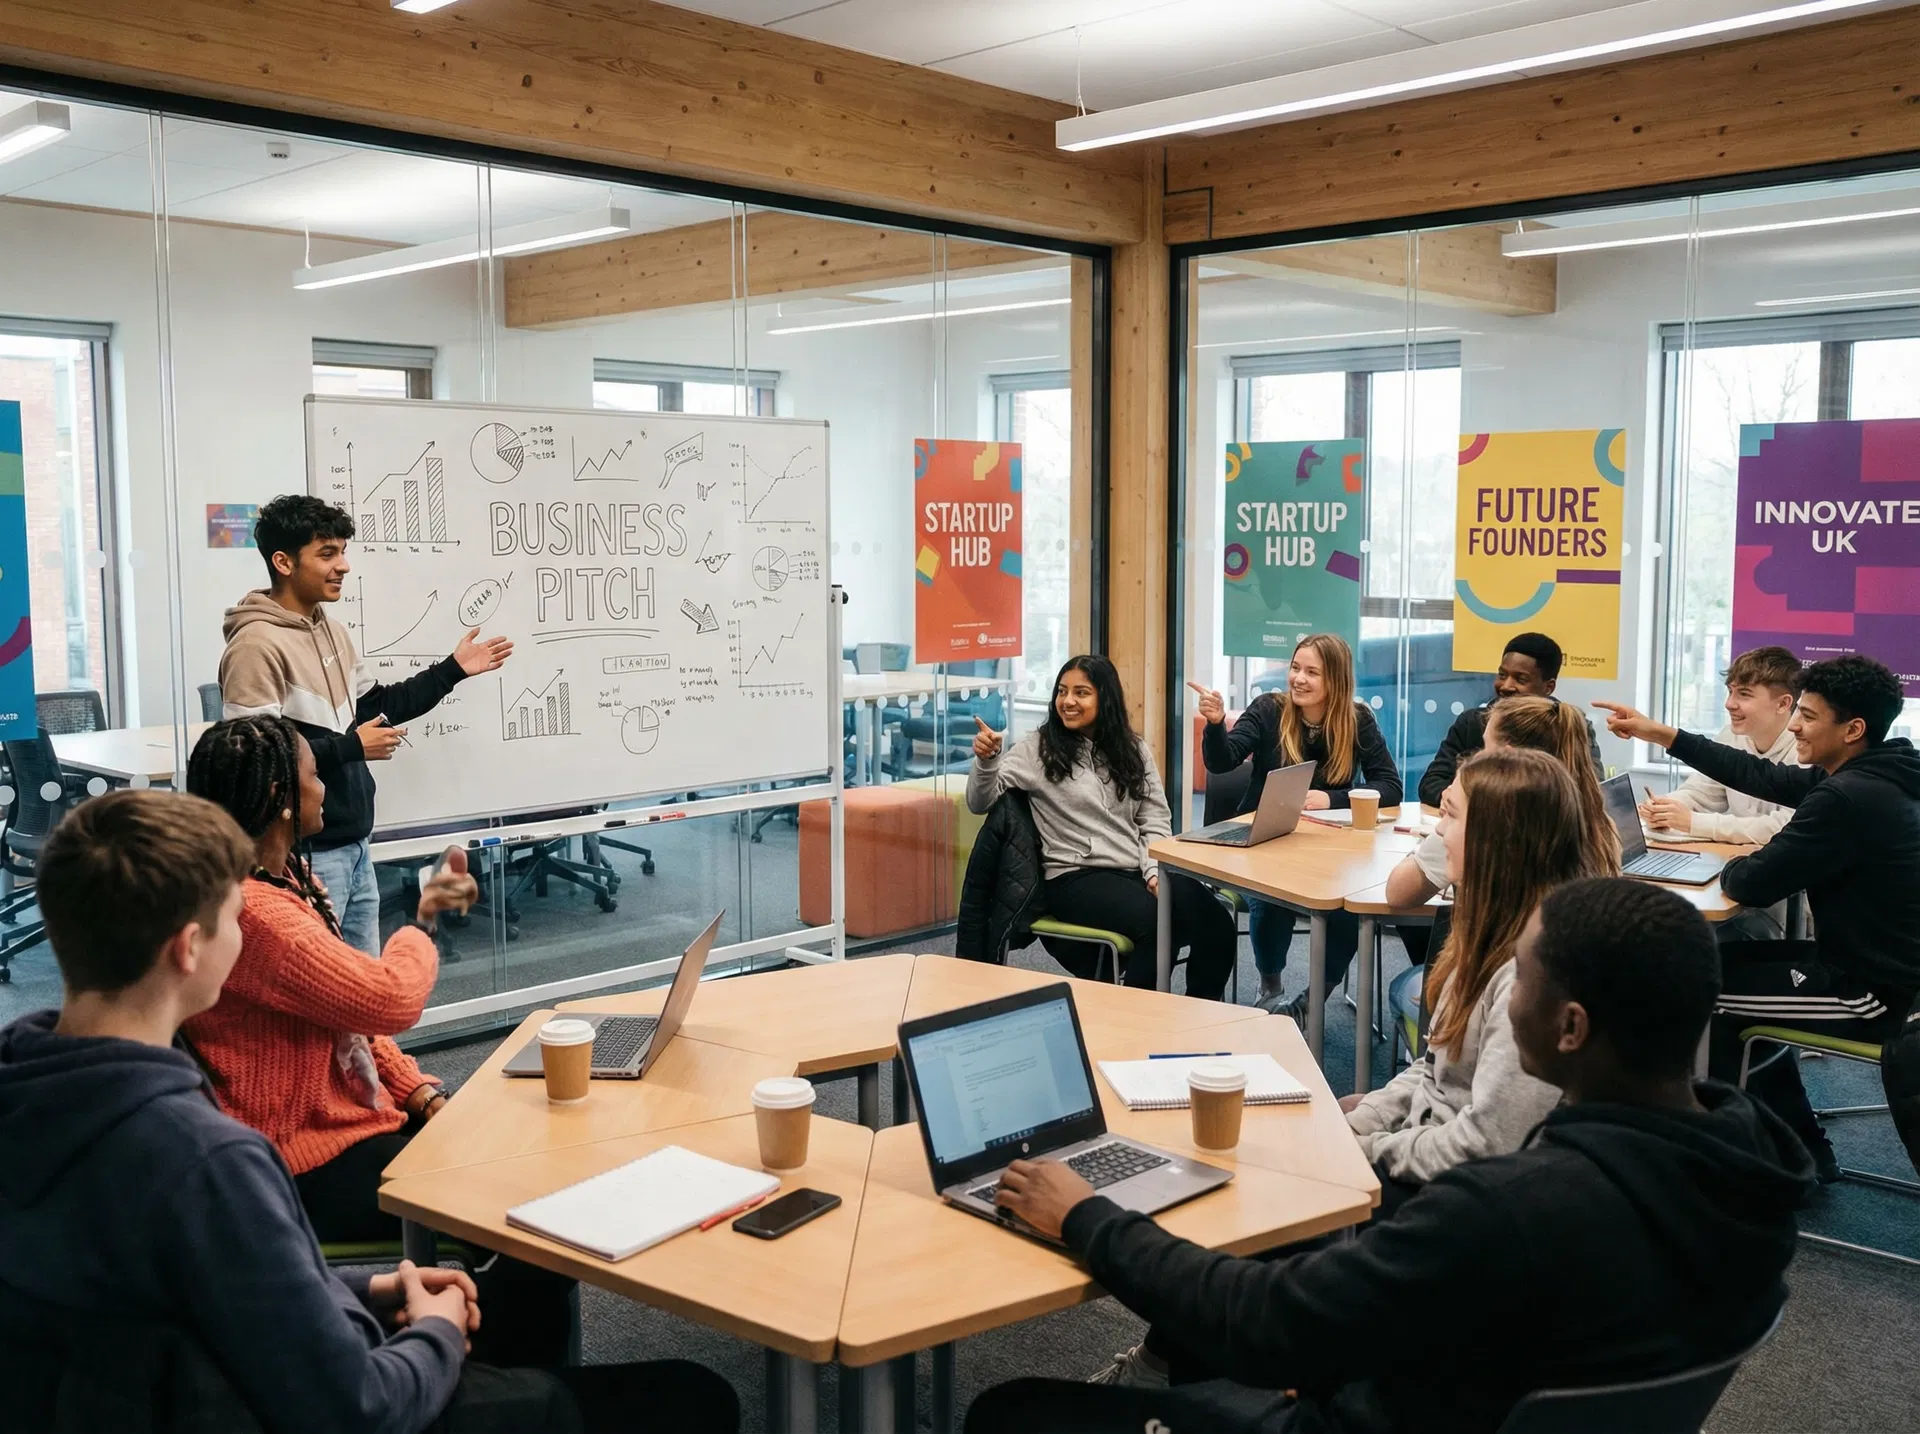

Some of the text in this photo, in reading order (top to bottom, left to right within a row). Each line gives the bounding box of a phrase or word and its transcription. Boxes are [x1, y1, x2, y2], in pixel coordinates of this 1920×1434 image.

[924, 502, 1014, 532] STARTUP
[1236, 501, 1348, 532] STARTUP
[1477, 487, 1600, 522] FUTURE
[1755, 500, 1920, 524] INNOVATE
[489, 501, 688, 557] BUSINESS
[1469, 527, 1607, 557] FOUNDERS
[1811, 530, 1857, 553] UK
[950, 536, 992, 567] HUB
[1264, 536, 1316, 567] HUB
[535, 566, 656, 623] PITCH
